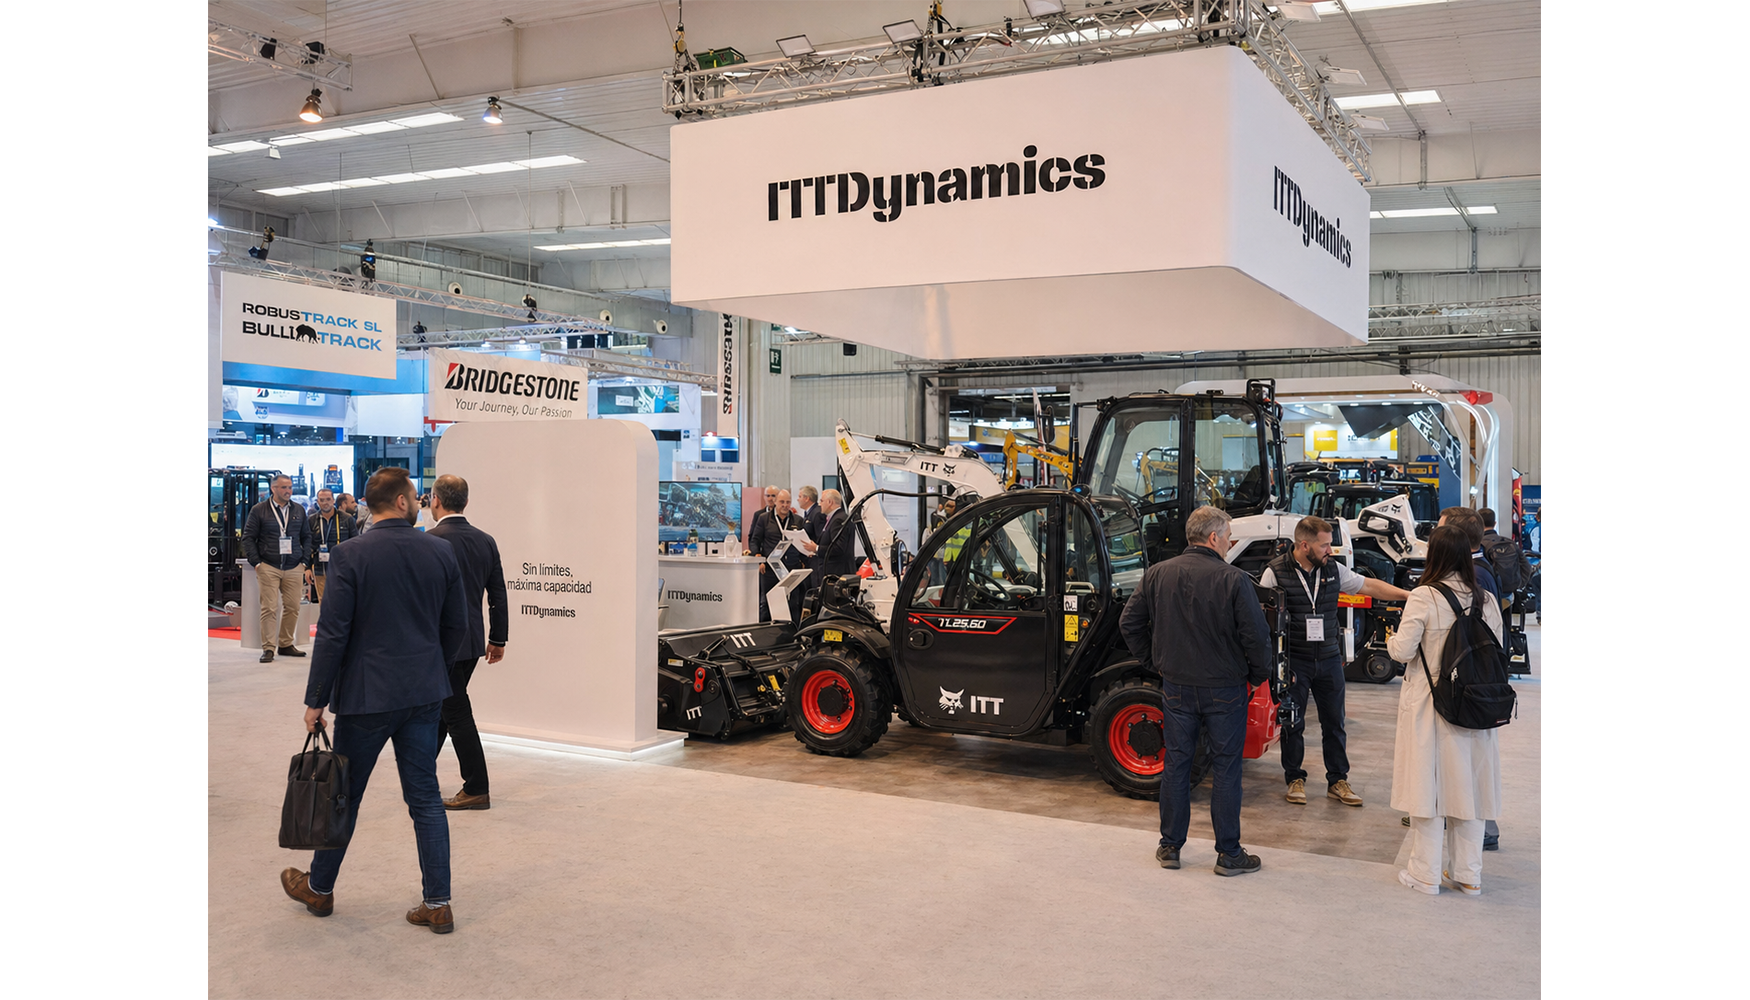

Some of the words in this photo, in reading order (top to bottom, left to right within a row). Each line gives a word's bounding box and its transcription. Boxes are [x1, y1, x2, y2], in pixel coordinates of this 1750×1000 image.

[767, 144, 1106, 223] ITTDynamics
[1273, 165, 1352, 269] ITTDynamics
[242, 302, 358, 330] ROBUSTRACK
[363, 320, 383, 333] SL
[444, 362, 580, 402] BRIDGESTONE
[455, 398, 478, 411] Your
[479, 401, 519, 417] Journey,
[521, 404, 539, 416] Our
[540, 406, 573, 419] Passion
[920, 460, 939, 473] ITT
[522, 562, 538, 576] Sin
[507, 578, 542, 592] máxima
[543, 579, 592, 596] capacidad
[667, 589, 723, 603] ITTDynamics
[521, 604, 576, 619] ITTDynamics
[729, 632, 757, 649] ITT
[685, 705, 703, 721] ITT
[970, 695, 1004, 716] ITT
